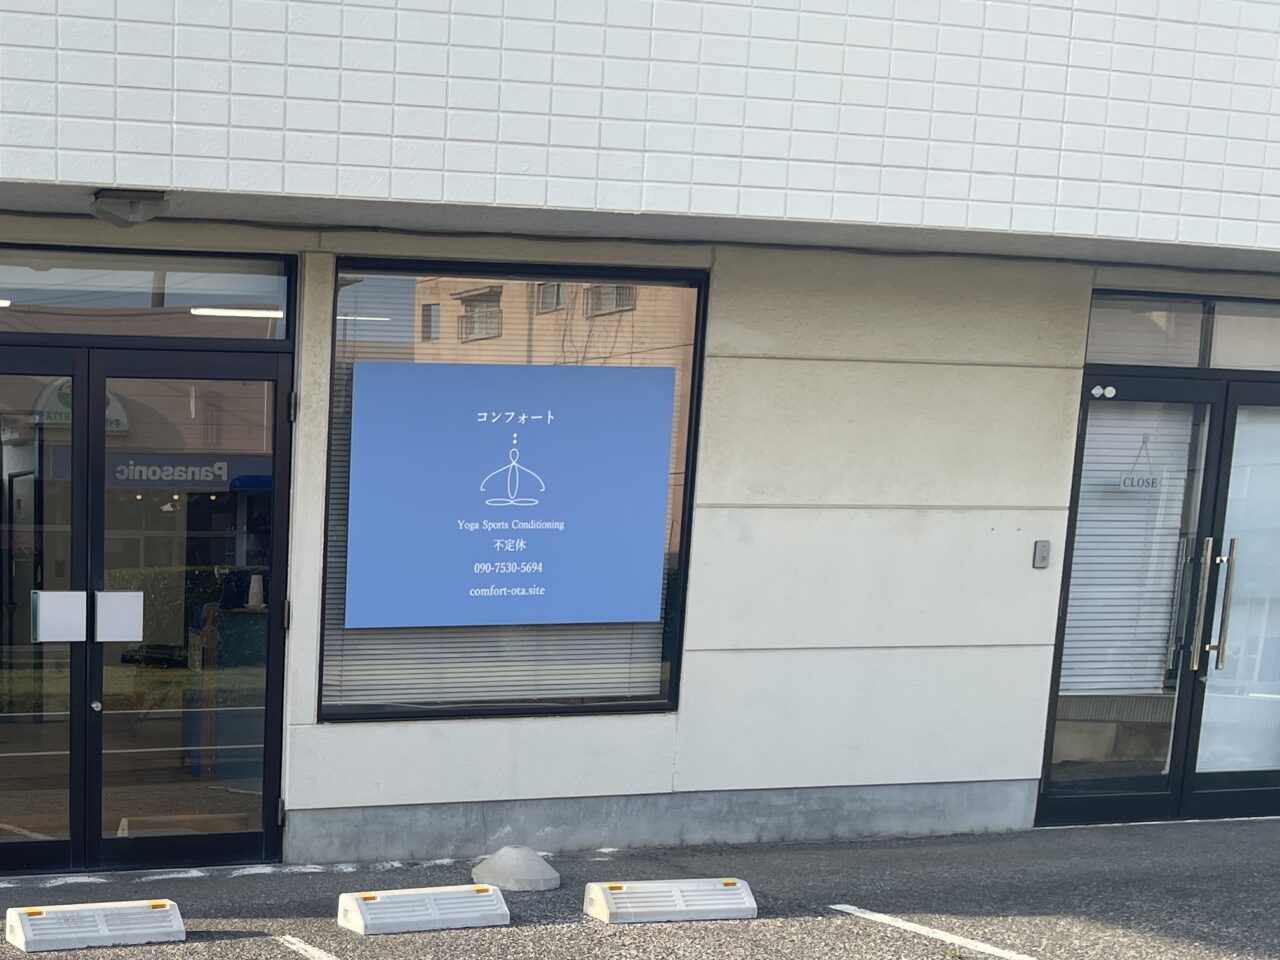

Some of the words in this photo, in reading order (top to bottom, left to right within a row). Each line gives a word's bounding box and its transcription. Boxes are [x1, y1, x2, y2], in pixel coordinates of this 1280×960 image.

[477, 410, 555, 424] コンフォート
[1123, 477, 1158, 488] CLOSE
[457, 519, 480, 531] Yoga
[482, 519, 509, 531] Sports
[511, 519, 565, 530] Conditioning
[493, 539, 526, 552] 不定休
[473, 562, 543, 574] 090-7530-5694
[468, 584, 546, 597] comfort-ota.site
